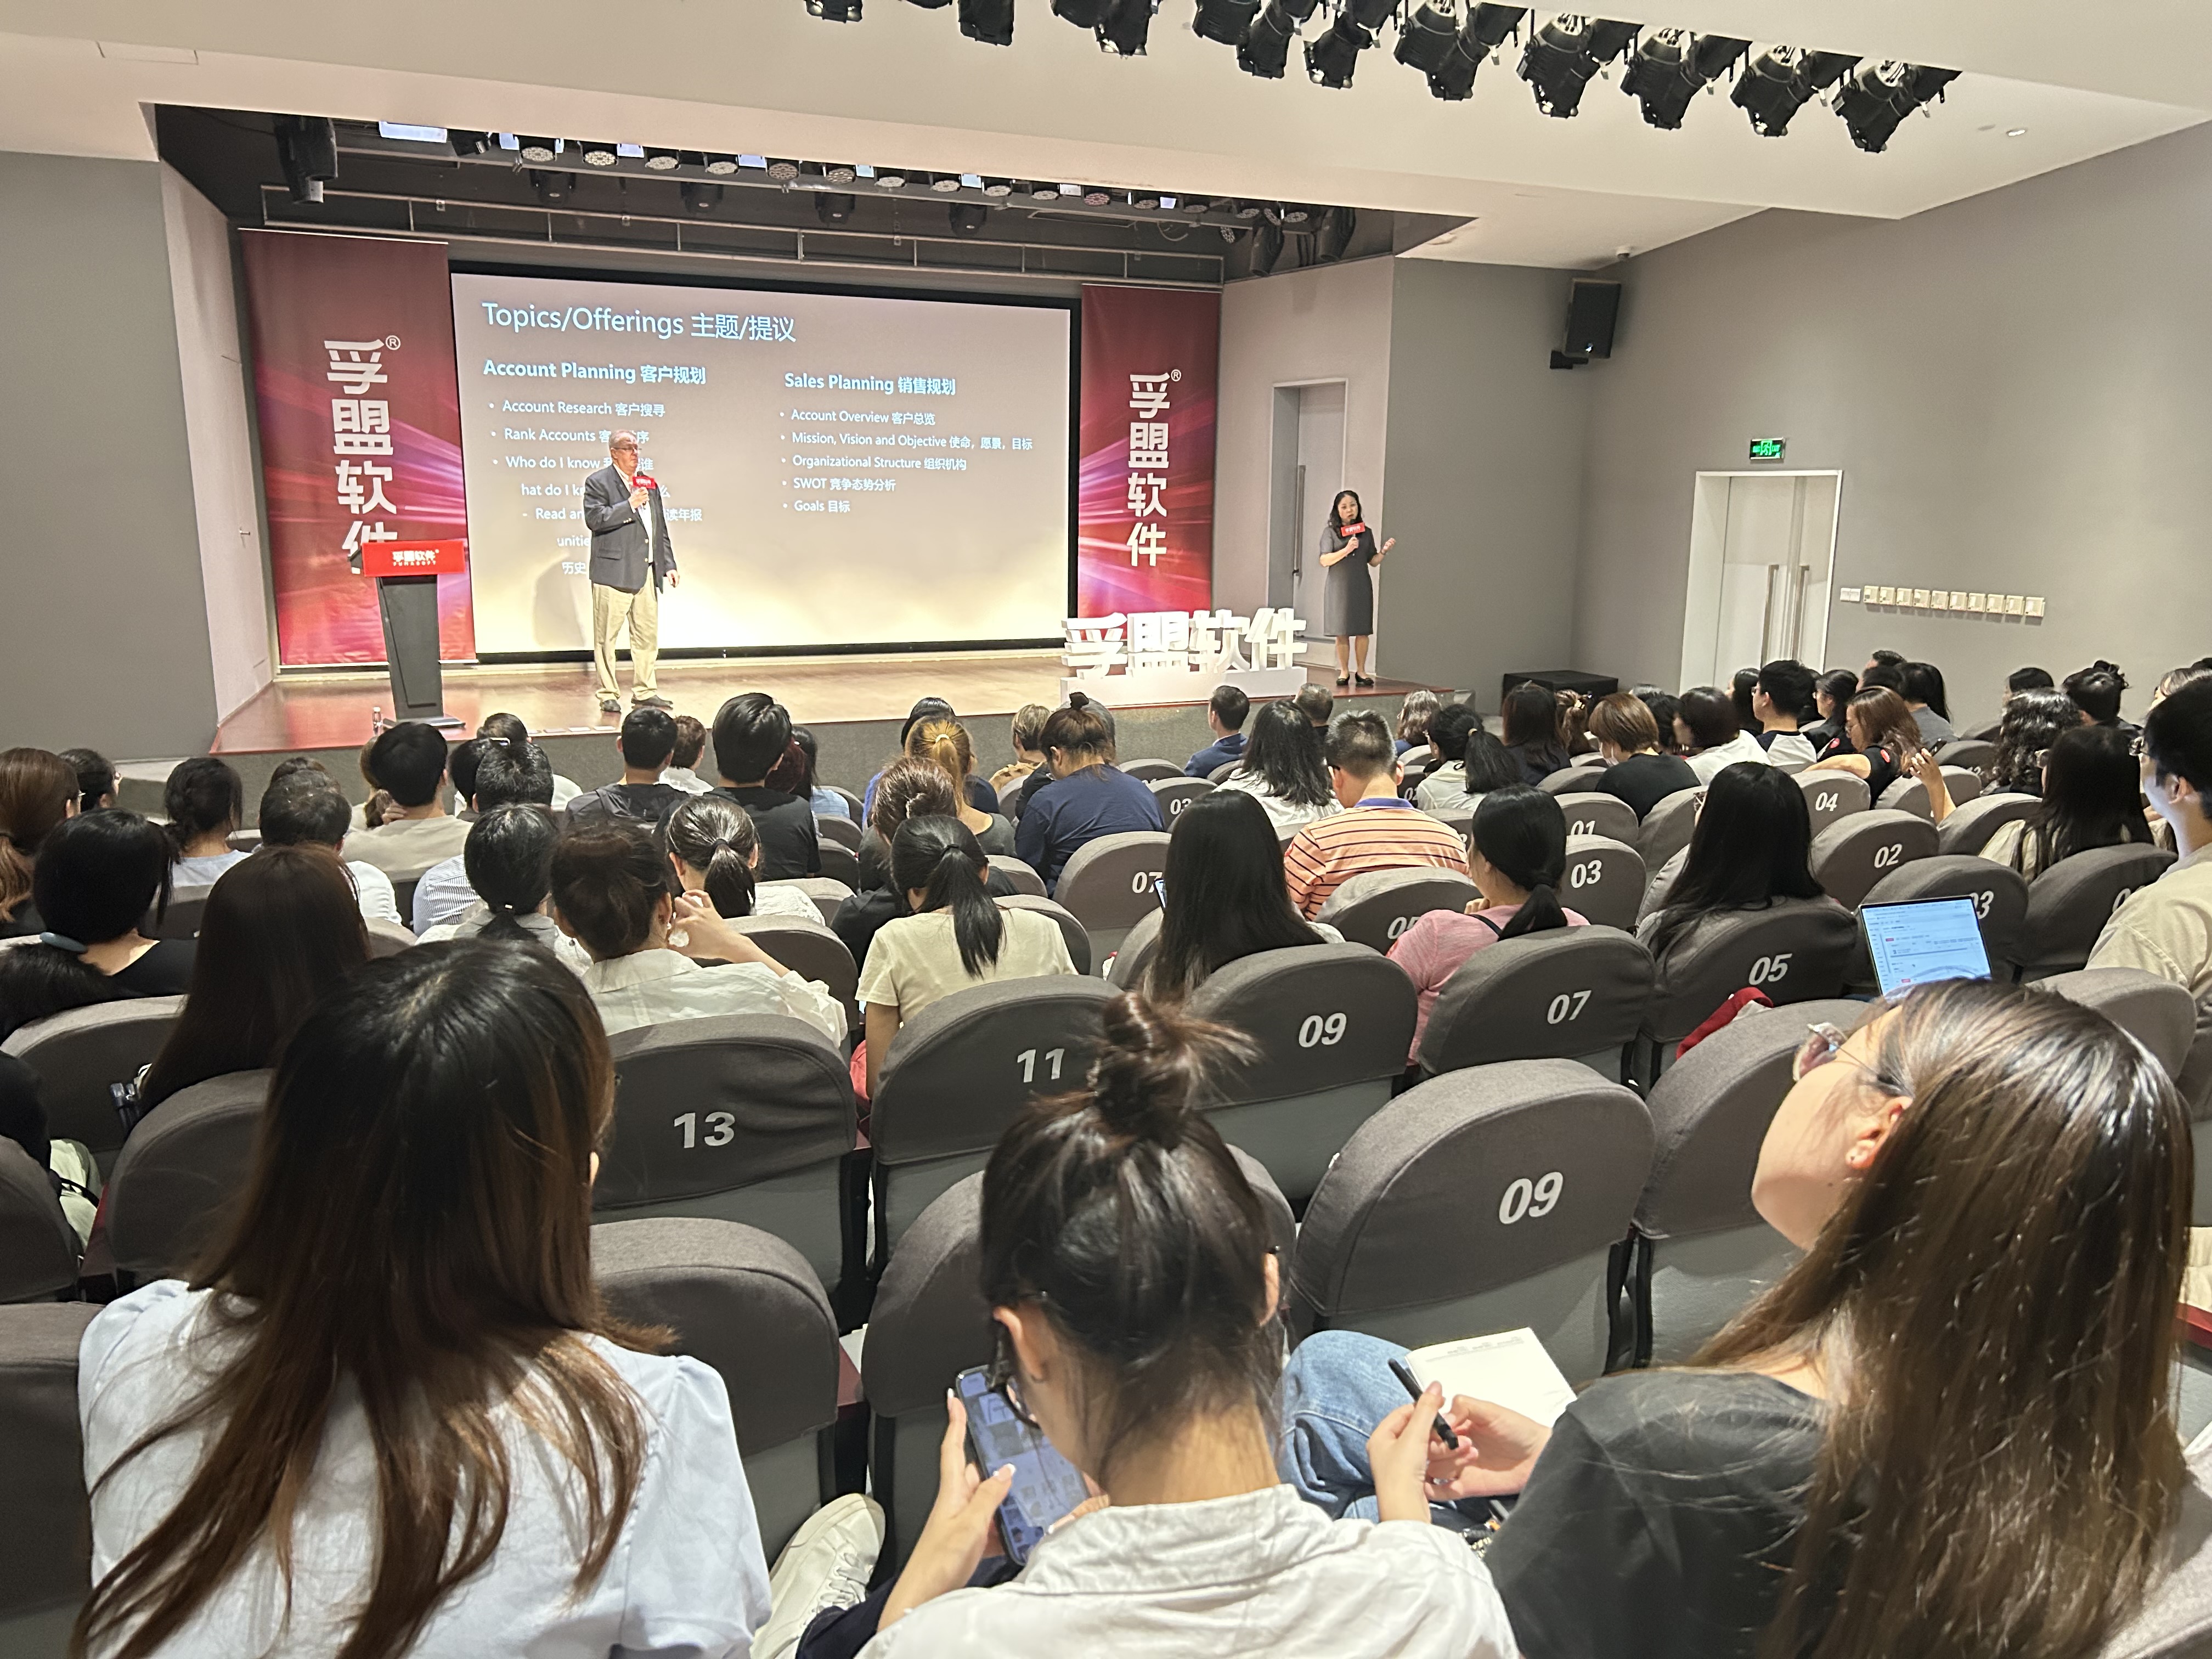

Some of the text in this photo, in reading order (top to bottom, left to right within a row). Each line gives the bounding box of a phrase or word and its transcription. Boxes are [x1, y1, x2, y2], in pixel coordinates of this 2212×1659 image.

[482, 303, 797, 343] Topics/Offerings 主题/提议
[484, 360, 707, 385] Account Planning 客户规划
[785, 373, 956, 396] Sales Planning 销售规划
[503, 400, 666, 418] Account Research 客户搜寻
[792, 409, 936, 426] Account Overview 客户总览
[505, 427, 537, 441] Rank
[539, 428, 596, 442] Accounts
[793, 432, 837, 446] Mission,
[839, 433, 873, 445] Vision
[876, 435, 896, 446] and
[898, 435, 947, 449] Objective
[506, 456, 537, 469] Who
[540, 456, 557, 469] do
[560, 458, 564, 469] I
[567, 457, 602, 471] know
[793, 455, 967, 471] Organizational Structure 组织机构
[1126, 372, 1171, 567] 孚盟软件
[545, 483, 562, 496] do
[794, 478, 897, 492] SWOT 竞争态势分析
[536, 508, 567, 520] Read
[663, 508, 703, 522] 读年报
[794, 500, 851, 514] Goals 目标
[1061, 607, 1308, 678] 孚盟软件
[1815, 792, 1838, 812] 04
[1874, 843, 1903, 868] 02
[1132, 871, 1163, 893] 07
[1571, 860, 1602, 888] 03
[1748, 953, 1793, 986] 05
[1547, 990, 1592, 1025] 07
[1299, 1012, 1347, 1048] 09
[1017, 1048, 1065, 1083] 11
[674, 1111, 736, 1148] 13
[1498, 1172, 1563, 1225] 09
